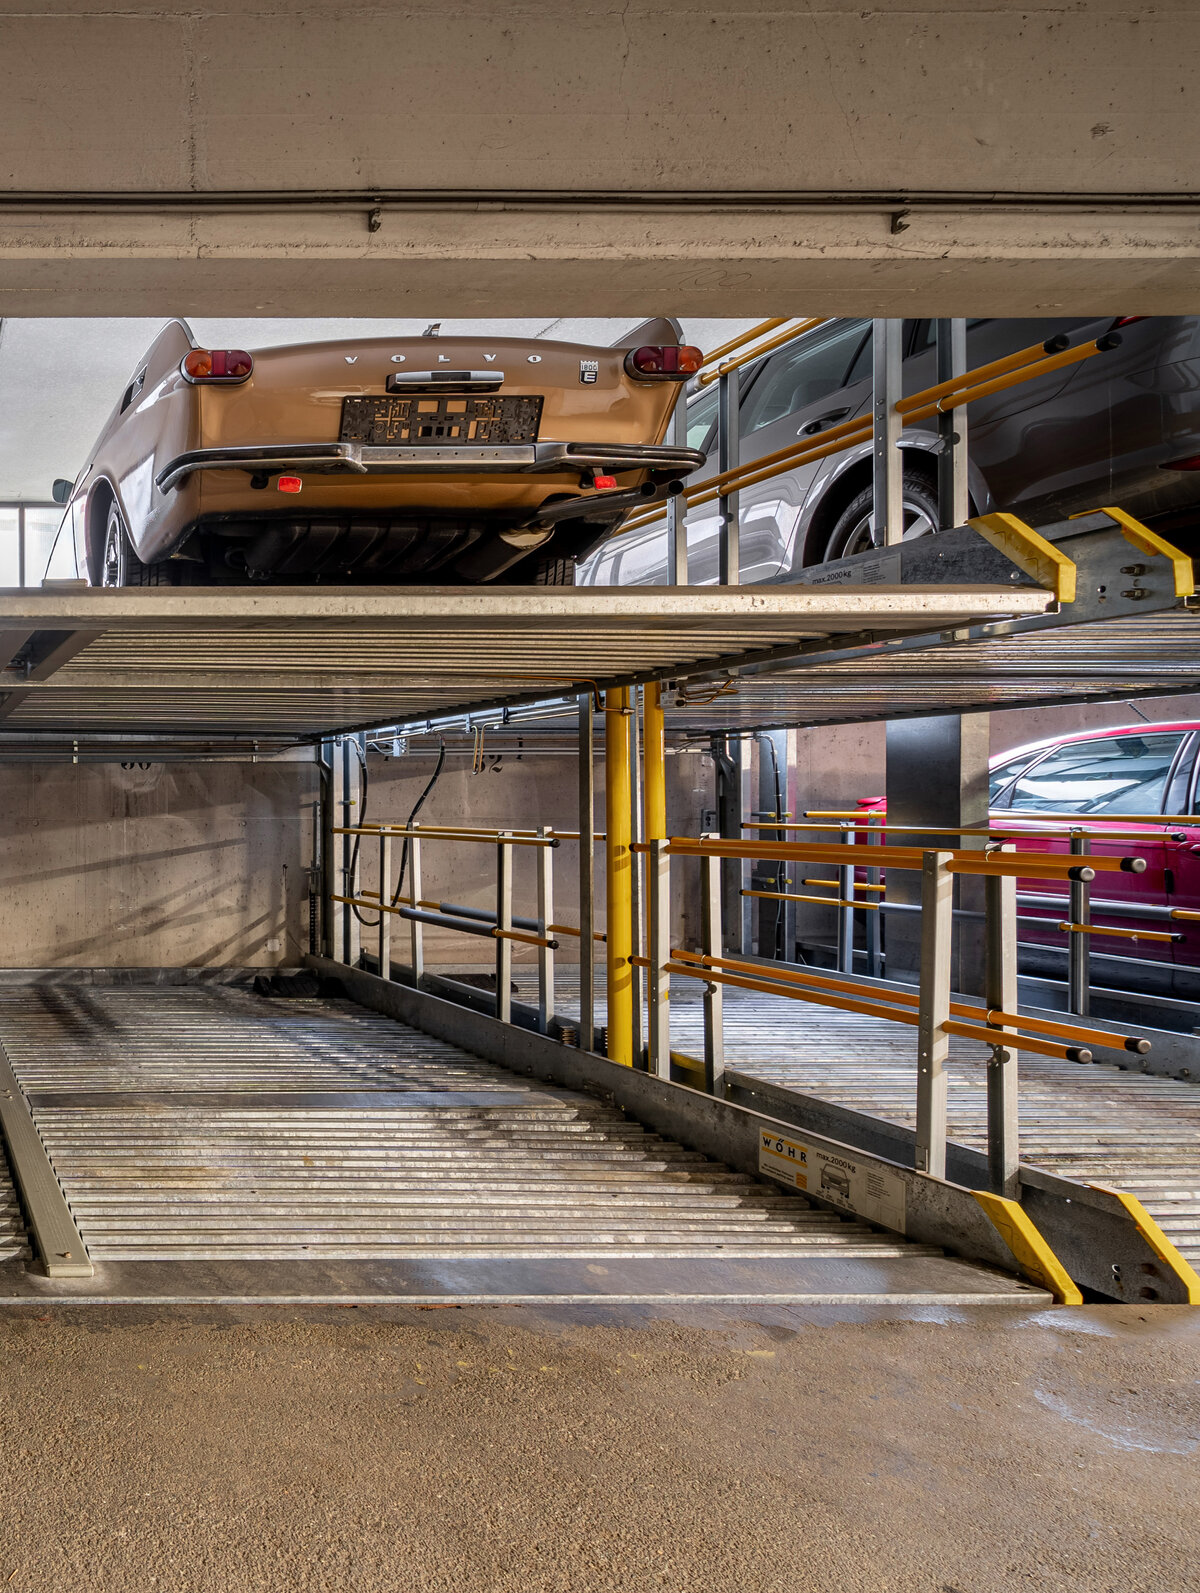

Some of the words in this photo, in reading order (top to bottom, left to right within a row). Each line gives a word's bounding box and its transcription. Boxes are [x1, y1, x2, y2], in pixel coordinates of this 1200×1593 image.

[344, 354, 542, 365] VOLVO
[584, 372, 596, 382] E
[763, 1137, 807, 1163] WÖHR
